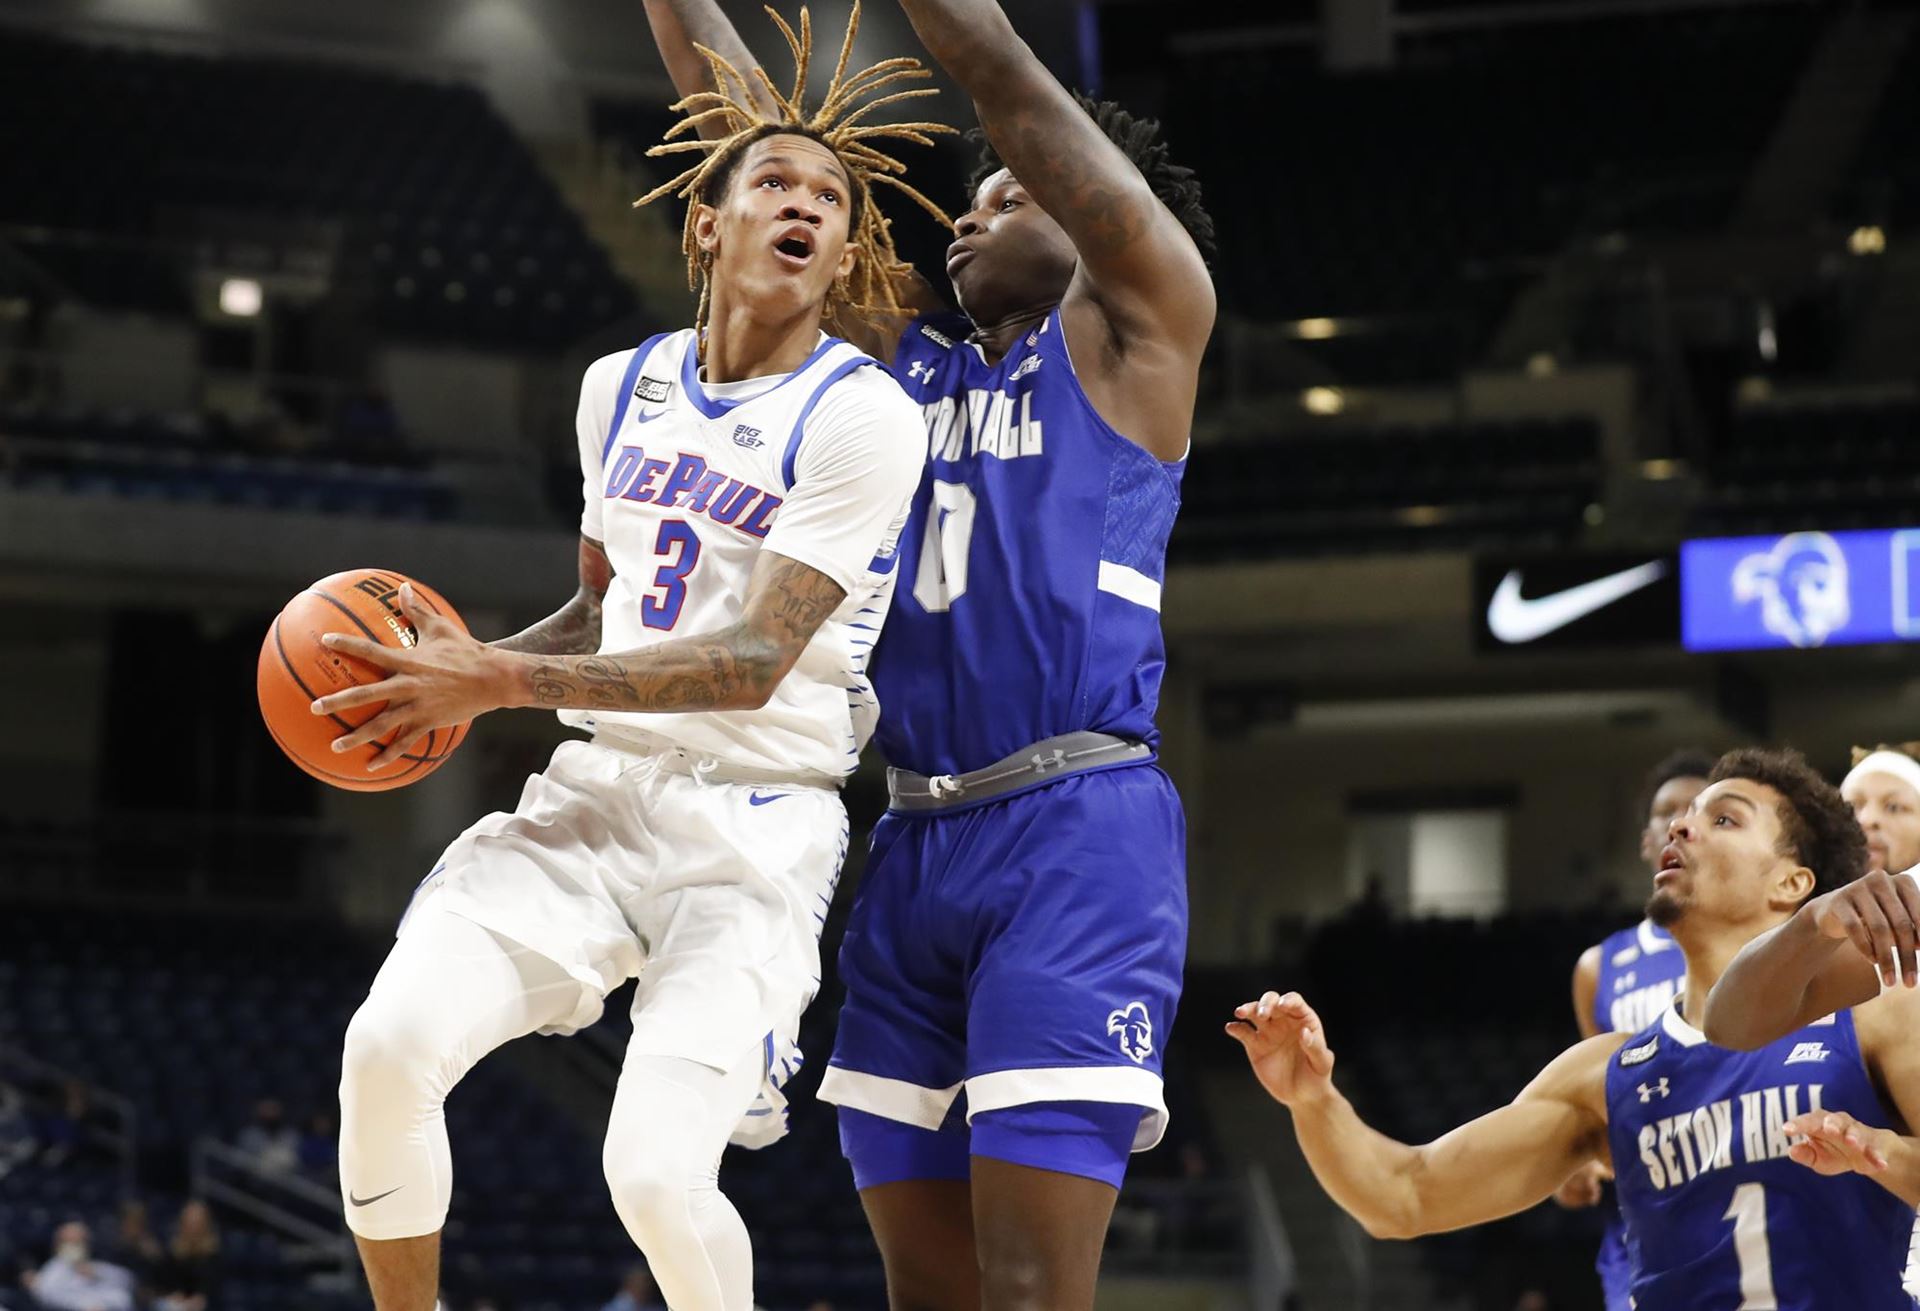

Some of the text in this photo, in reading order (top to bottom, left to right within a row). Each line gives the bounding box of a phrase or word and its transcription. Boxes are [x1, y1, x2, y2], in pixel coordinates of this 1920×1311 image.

[733, 433, 765, 448] EAST
[735, 424, 762, 438] BIG
[641, 519, 701, 631] 3
[913, 479, 977, 613] 0
[1637, 1098, 1733, 1190] SETON
[1722, 1182, 1778, 1311] 1
